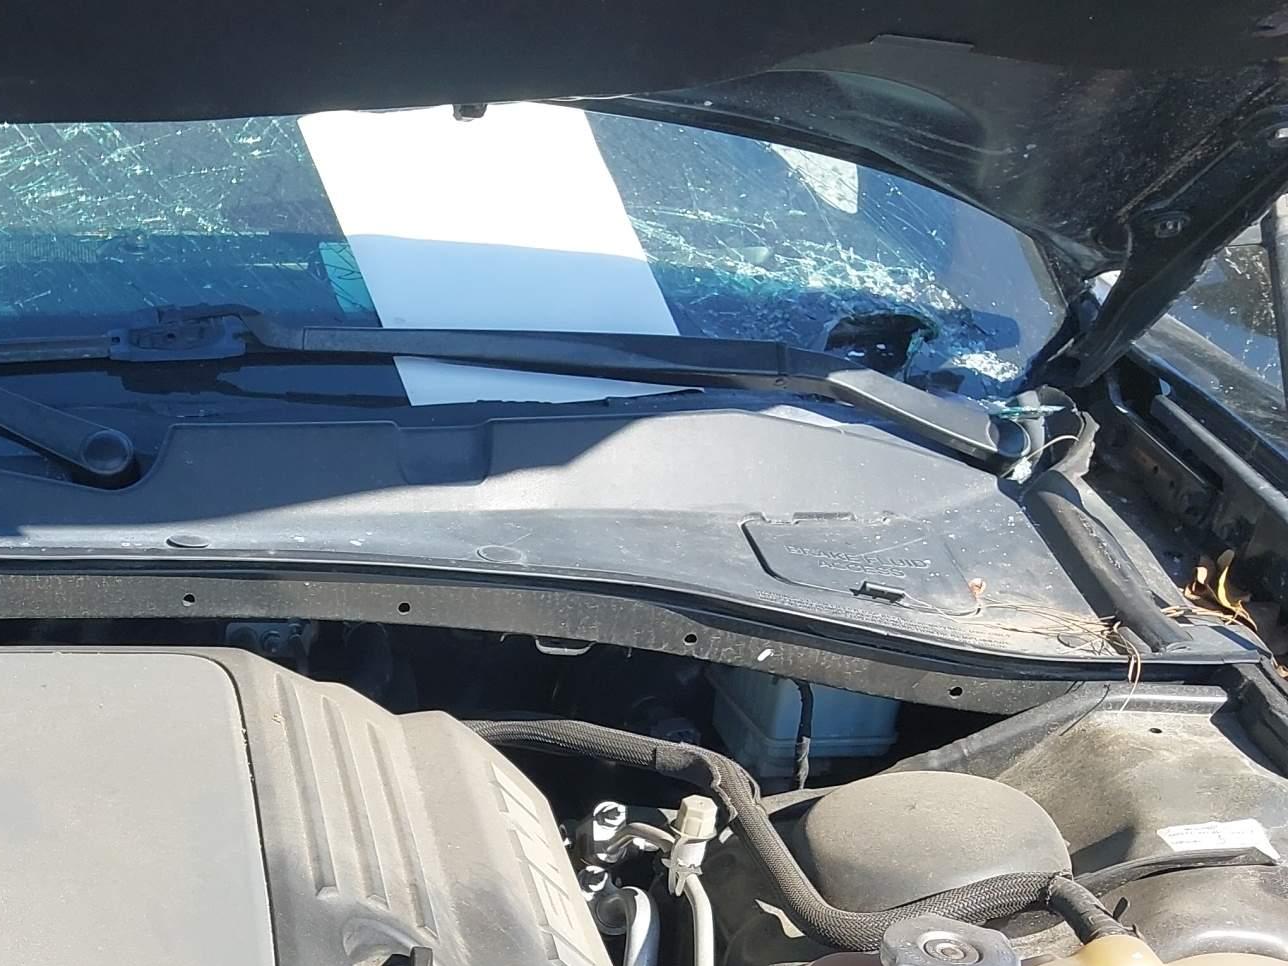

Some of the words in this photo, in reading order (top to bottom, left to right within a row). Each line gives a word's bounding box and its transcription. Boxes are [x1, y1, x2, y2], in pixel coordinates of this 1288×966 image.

[784, 545, 860, 563] BRAKE
[862, 556, 931, 569] FLUID
[818, 559, 906, 578] ACCESS
